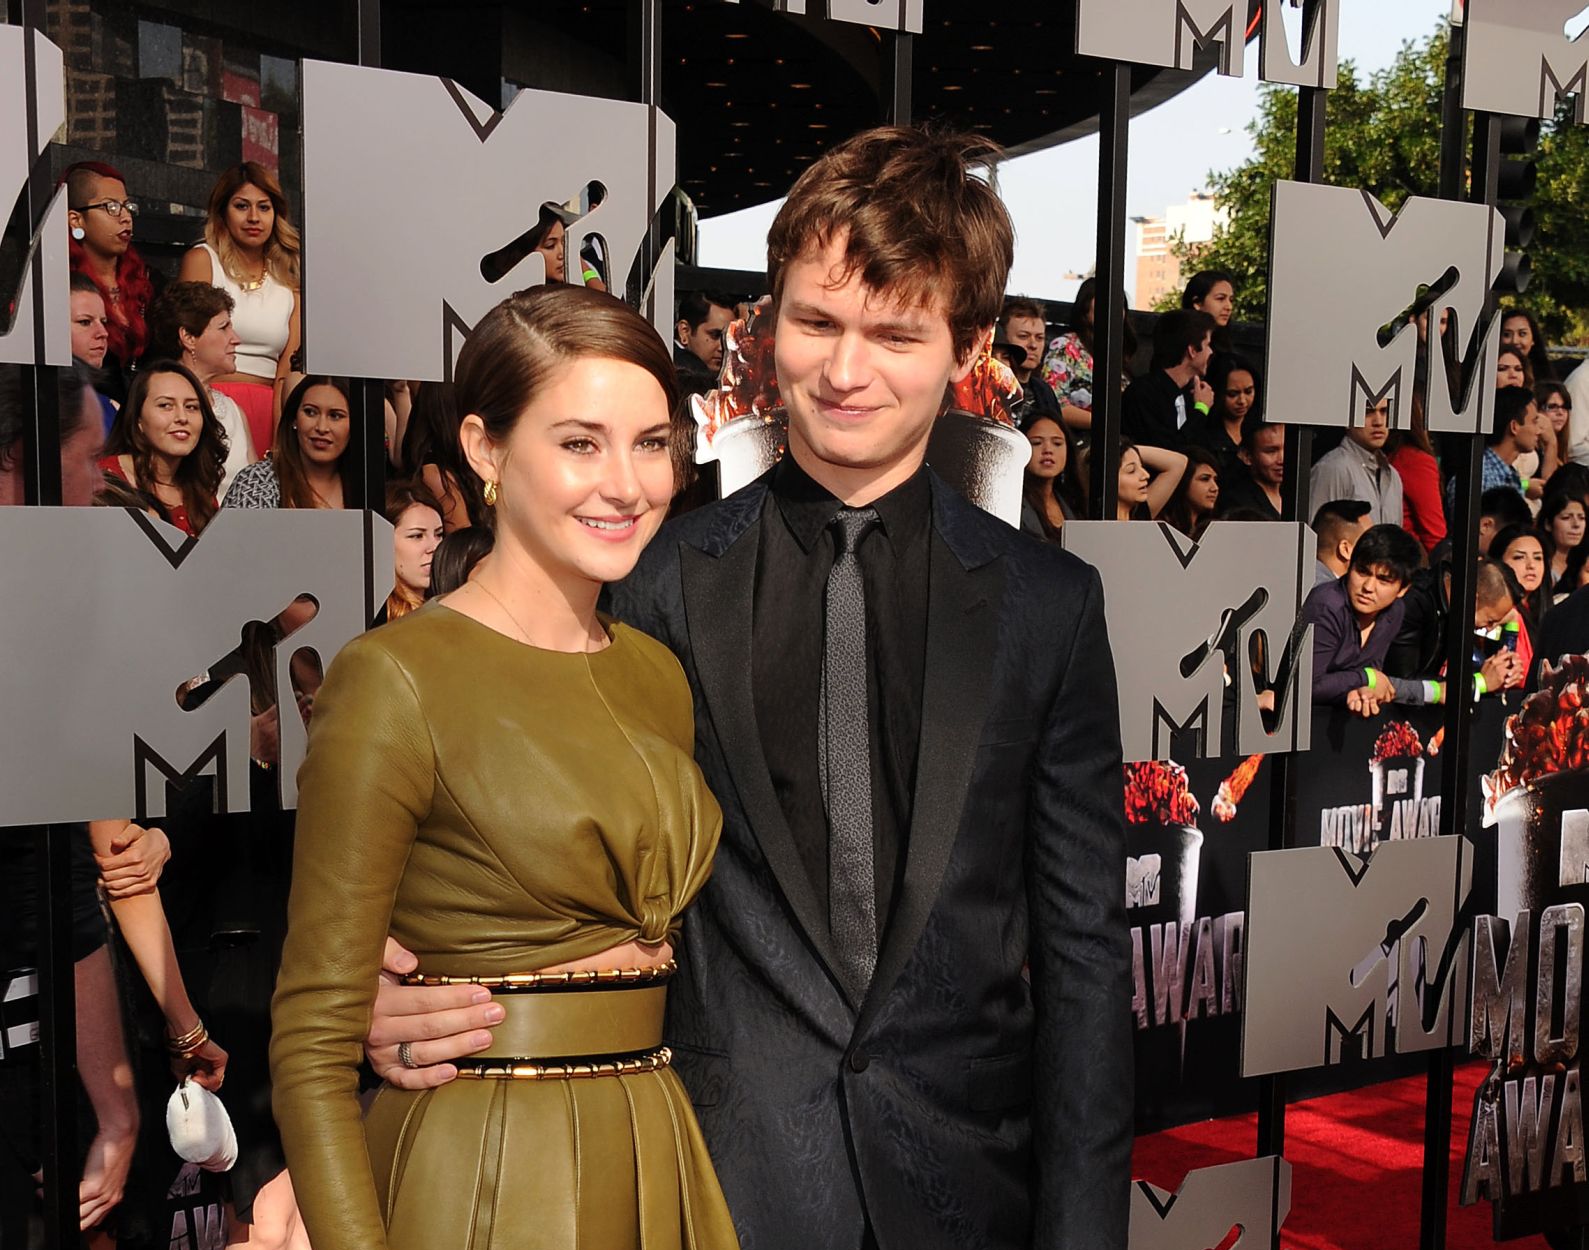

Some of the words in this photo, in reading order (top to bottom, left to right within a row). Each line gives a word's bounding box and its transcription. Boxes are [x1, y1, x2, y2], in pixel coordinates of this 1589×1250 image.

[1266, 180, 1506, 433] MTV
[1062, 520, 1318, 762] MTV
[1125, 853, 1162, 909] MTV
[1241, 834, 1474, 1078] MTV
